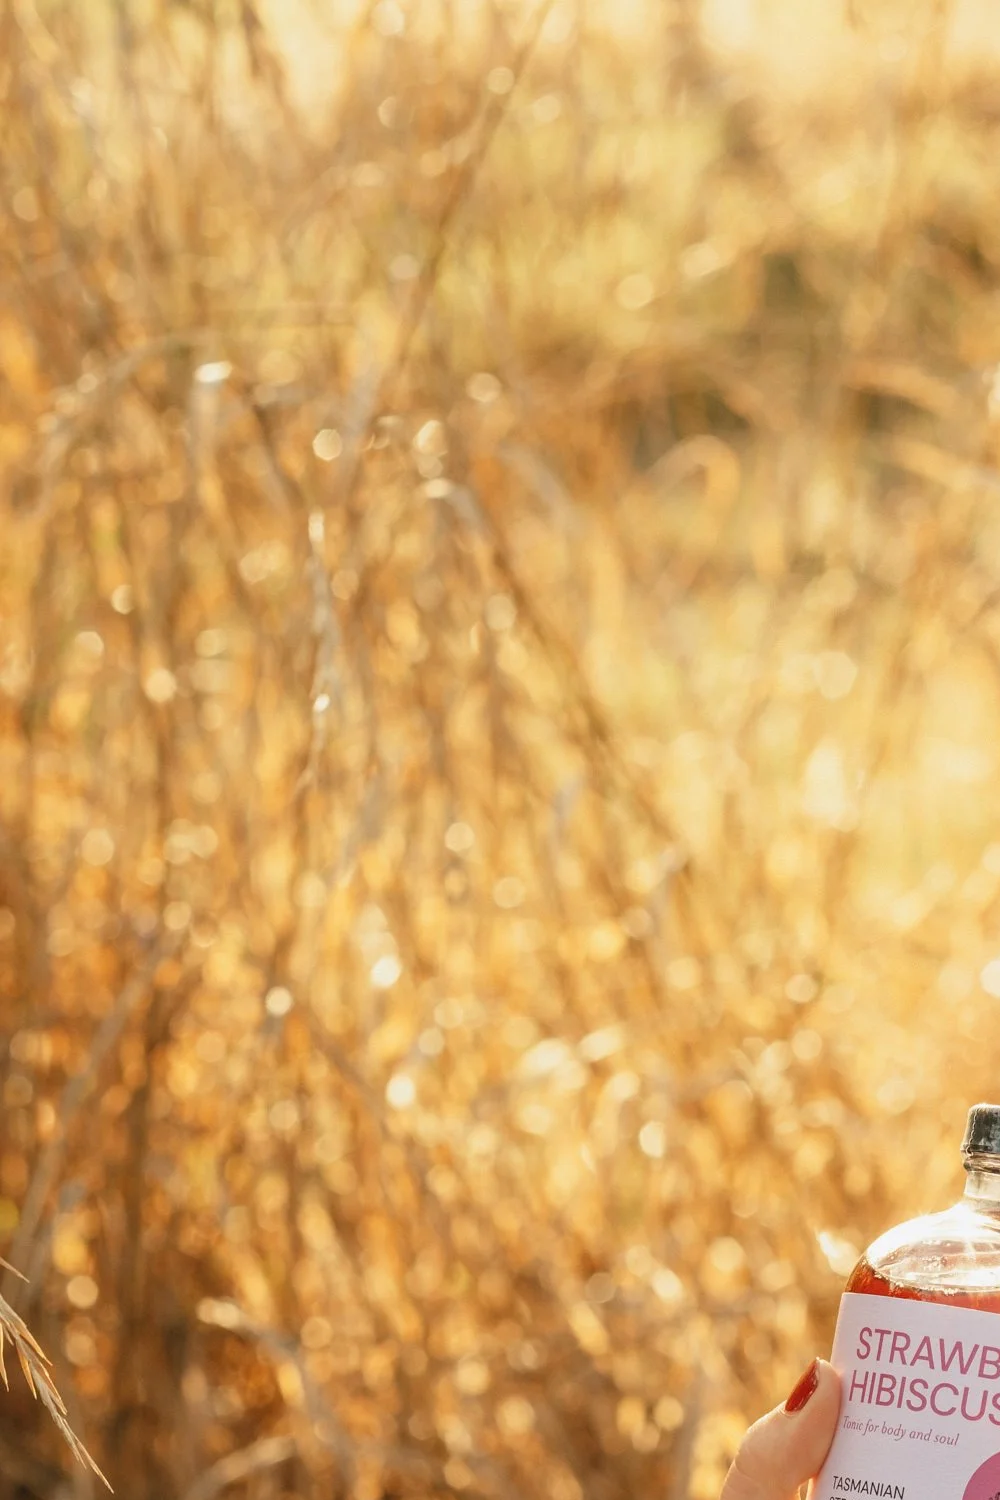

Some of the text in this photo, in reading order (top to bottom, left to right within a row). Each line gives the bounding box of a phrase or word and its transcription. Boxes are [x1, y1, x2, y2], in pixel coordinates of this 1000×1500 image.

[843, 1415, 960, 1446] Tonic for body and soul
[833, 1475, 905, 1500] TASMANIAN
